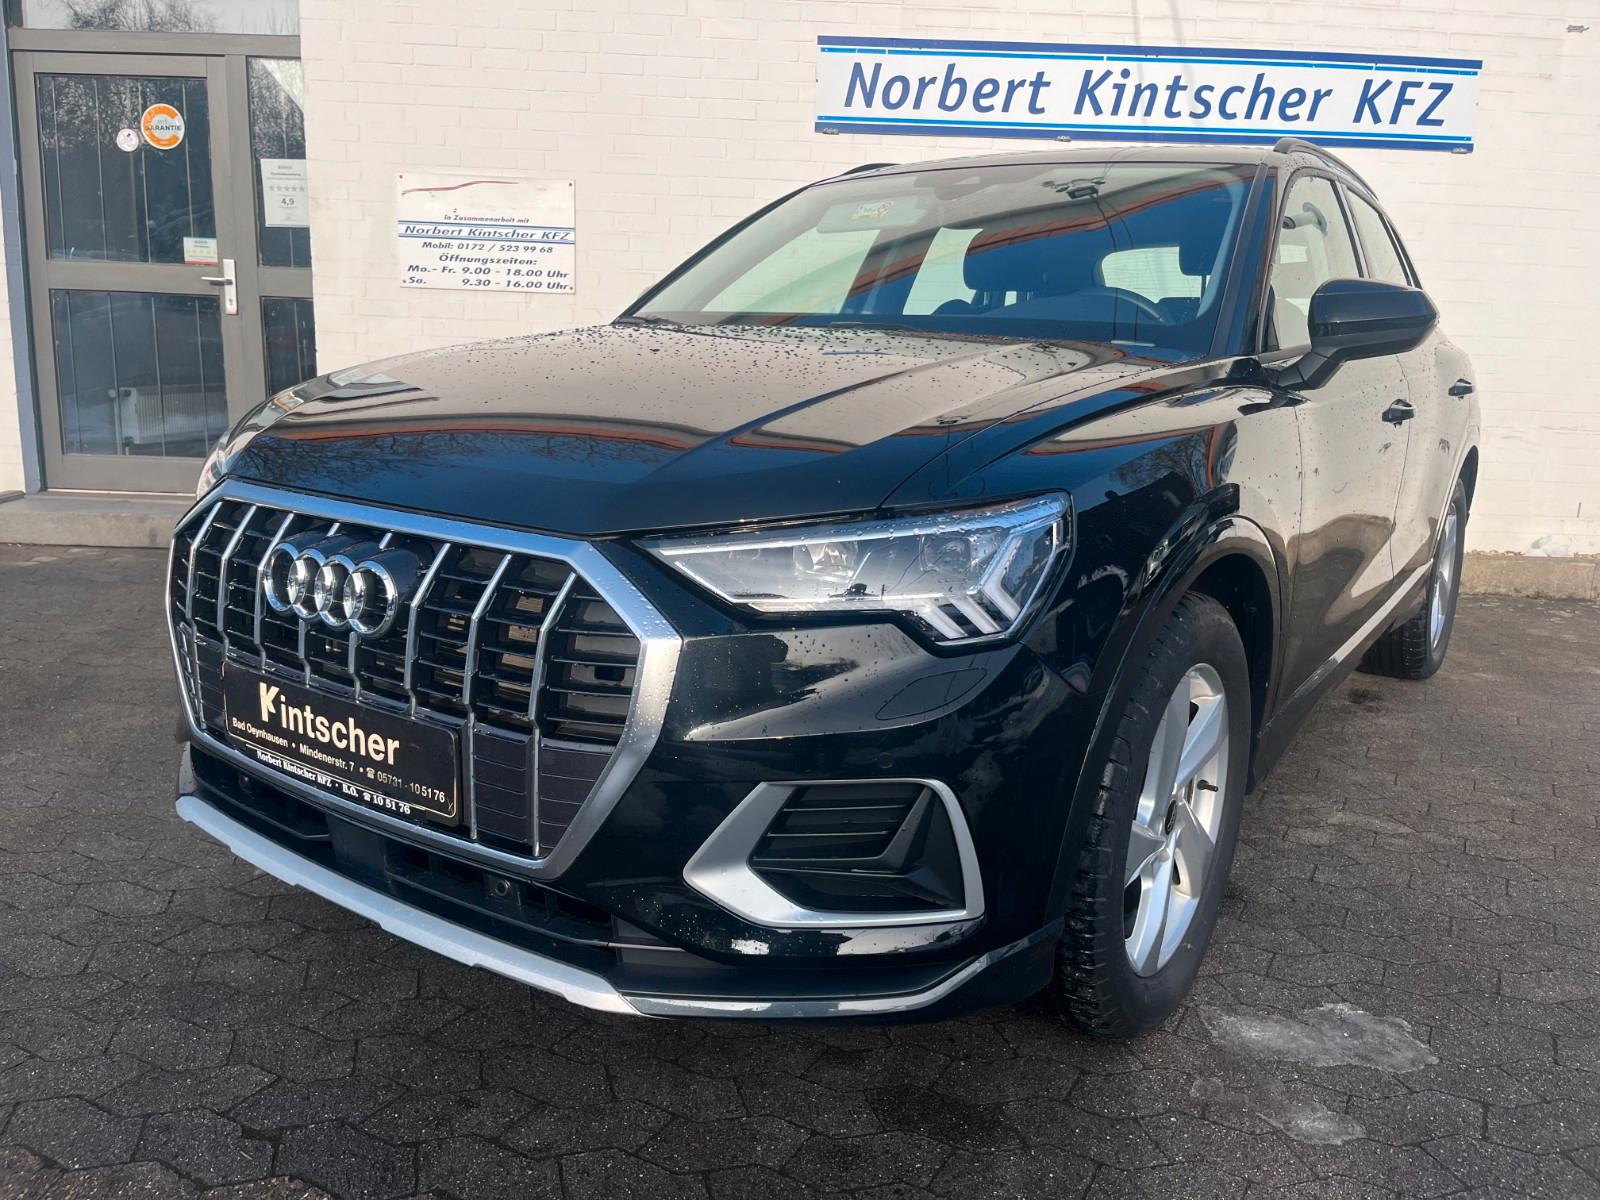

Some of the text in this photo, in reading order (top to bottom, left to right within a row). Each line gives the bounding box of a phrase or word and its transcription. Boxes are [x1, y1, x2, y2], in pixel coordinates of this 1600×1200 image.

[844, 62, 1454, 126] Norbert Kintscher KFZ
[280, 197, 295, 207] 4,9
[453, 214, 515, 223] Zusammenarbeit
[404, 225, 571, 240] Norbert Kintscher KFZ
[422, 241, 454, 249] Mobil:
[457, 242, 485, 251] 0172
[487, 243, 496, 252] /
[498, 244, 520, 252] 523
[439, 252, 538, 265] Öffnungszeiten:
[441, 266, 456, 274] Fr.
[462, 266, 491, 275] 9.00
[506, 268, 543, 277] 18.00
[547, 270, 569, 279] Uhr
[408, 276, 427, 284] Sa.
[462, 278, 491, 287] 9.30
[506, 280, 543, 289] 16.00
[547, 282, 569, 290] Uhr
[259, 682, 399, 765] Kintscher
[232, 717, 246, 731] Bad
[246, 723, 289, 748] Oeynhausen
[299, 743, 348, 770] Mindenerstr.
[349, 761, 355, 772] 7
[377, 771, 403, 789] 05731
[256, 750, 411, 815] Norbert Kintscher KFZ B.O. 10 51 76
